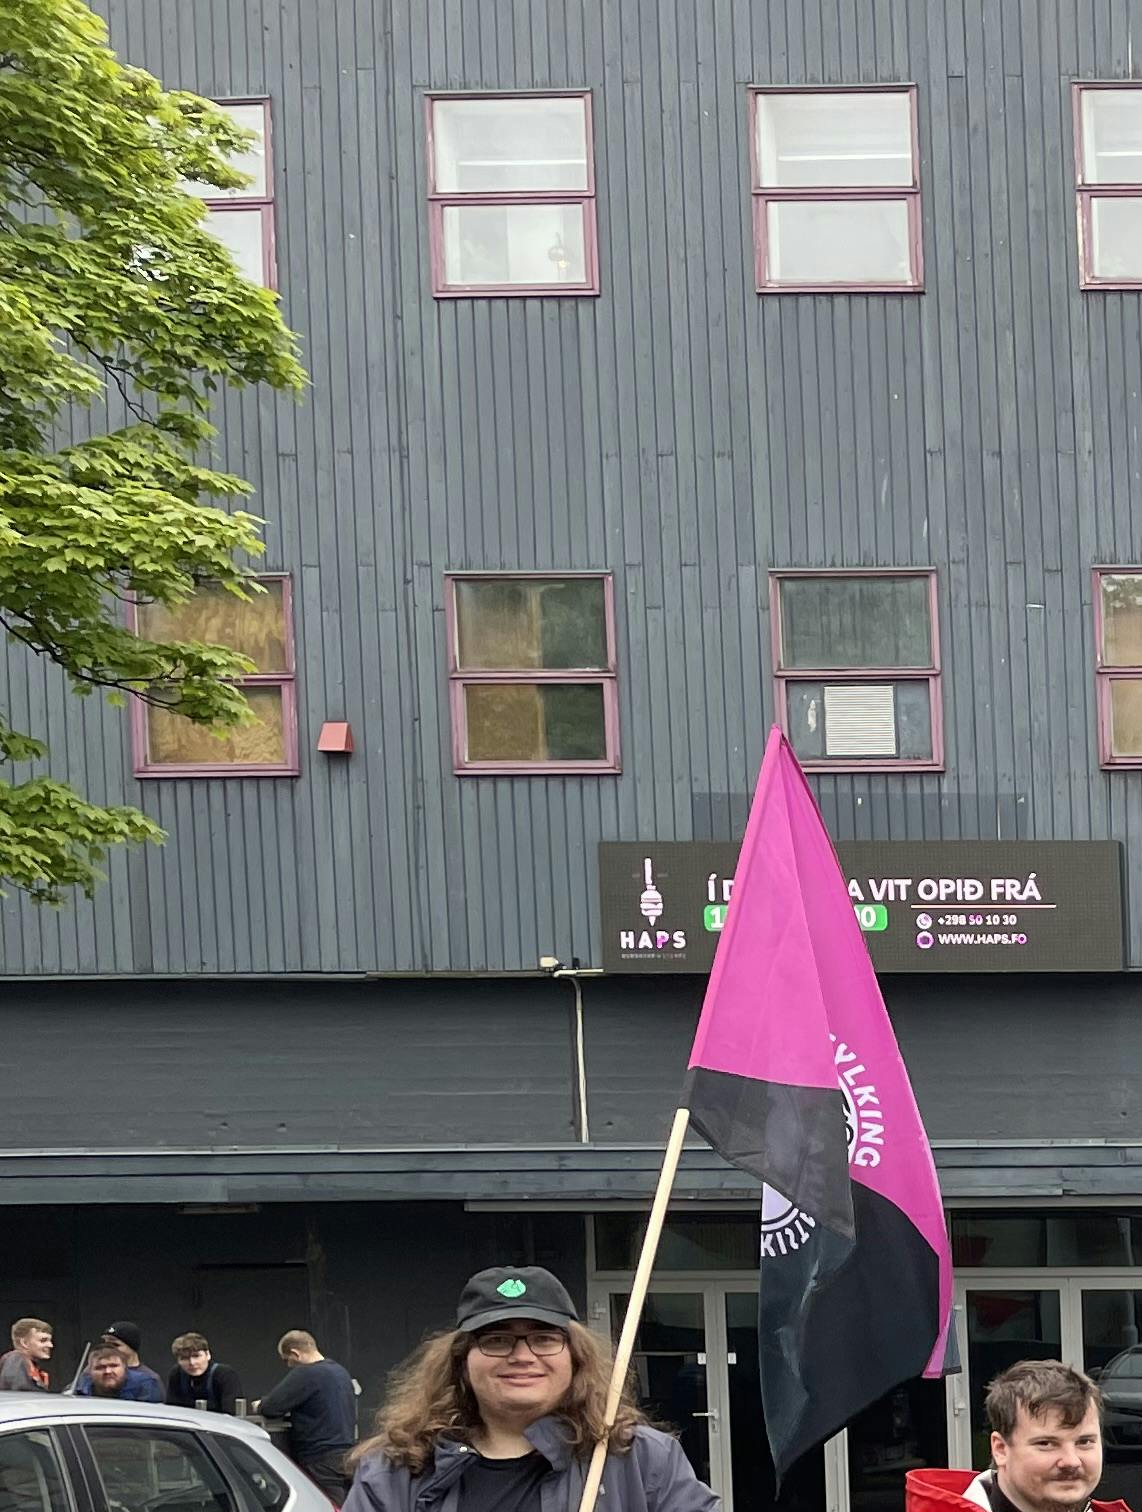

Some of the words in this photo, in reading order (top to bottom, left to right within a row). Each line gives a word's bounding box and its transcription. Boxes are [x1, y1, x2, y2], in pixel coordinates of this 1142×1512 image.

[868, 878, 912, 901] VIT
[917, 878, 984, 901] OPIÐ
[990, 872, 1042, 901] FRÁ
[968, 914, 984, 926] 50
[985, 914, 1000, 926] 10
[1001, 914, 1017, 926] 30
[620, 930, 687, 949] HAPS
[937, 933, 1027, 945] WWW.HAPS.FO
